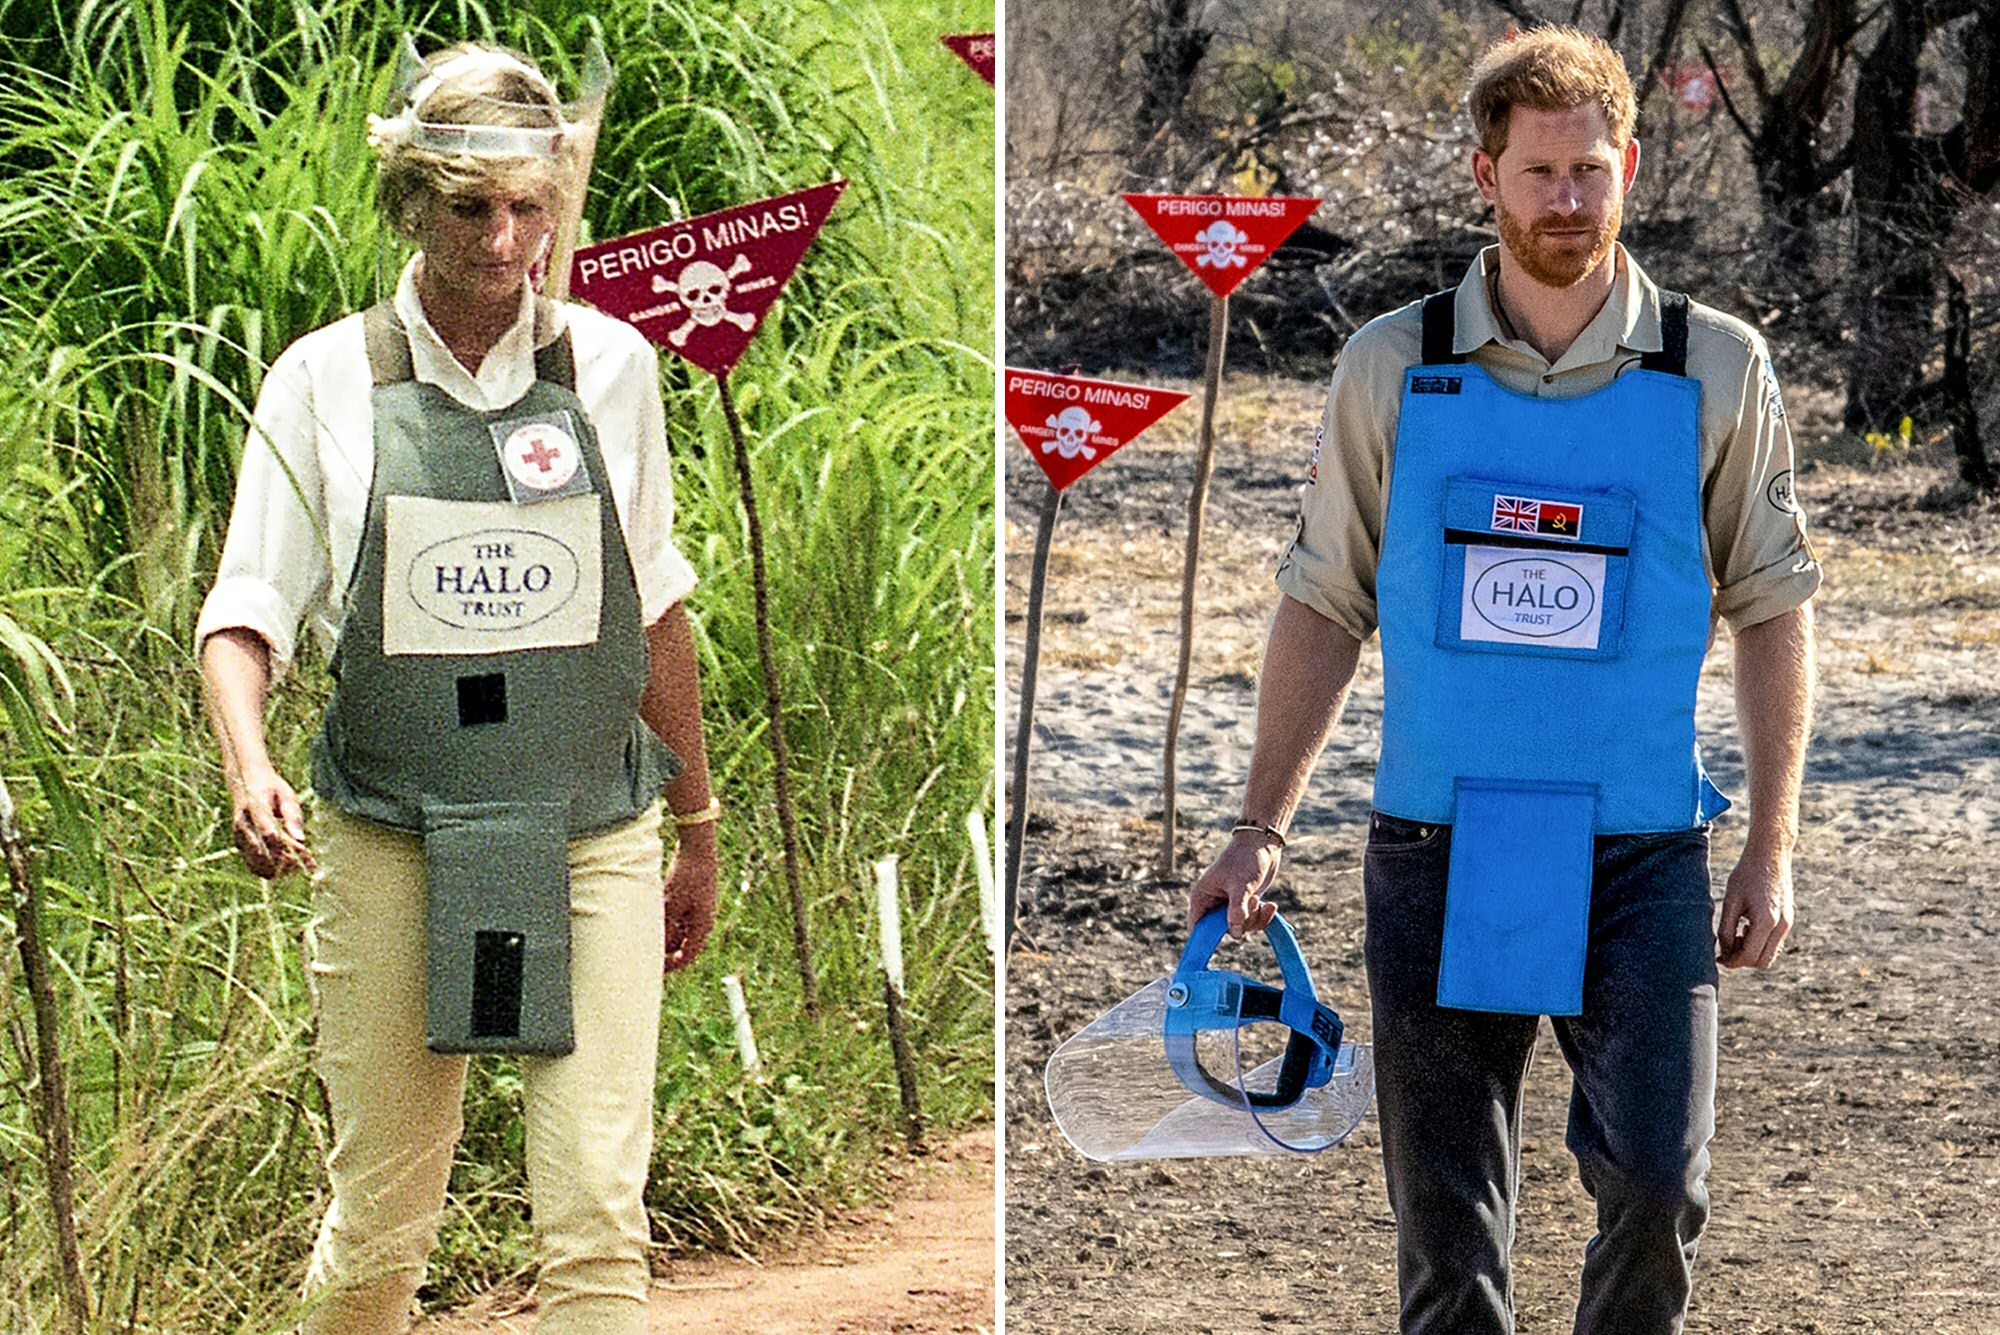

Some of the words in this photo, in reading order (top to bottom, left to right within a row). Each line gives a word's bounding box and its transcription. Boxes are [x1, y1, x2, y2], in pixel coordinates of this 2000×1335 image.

[1157, 200, 1222, 216] PERIGO
[1226, 202, 1286, 217] MINAS!
[579, 233, 697, 285] PERIGO
[703, 203, 810, 252] MINAS!
[1009, 377, 1081, 401] PERIGO
[1084, 387, 1151, 410] MINAS!
[1019, 424, 1056, 438] DANGER
[1091, 434, 1120, 447] MINES
[473, 543, 516, 559] THE
[435, 564, 553, 595] HALO
[1522, 569, 1546, 580] THE
[1492, 581, 1578, 610] HALO
[461, 600, 525, 618] TRUST
[1515, 613, 1553, 624] TRUST
